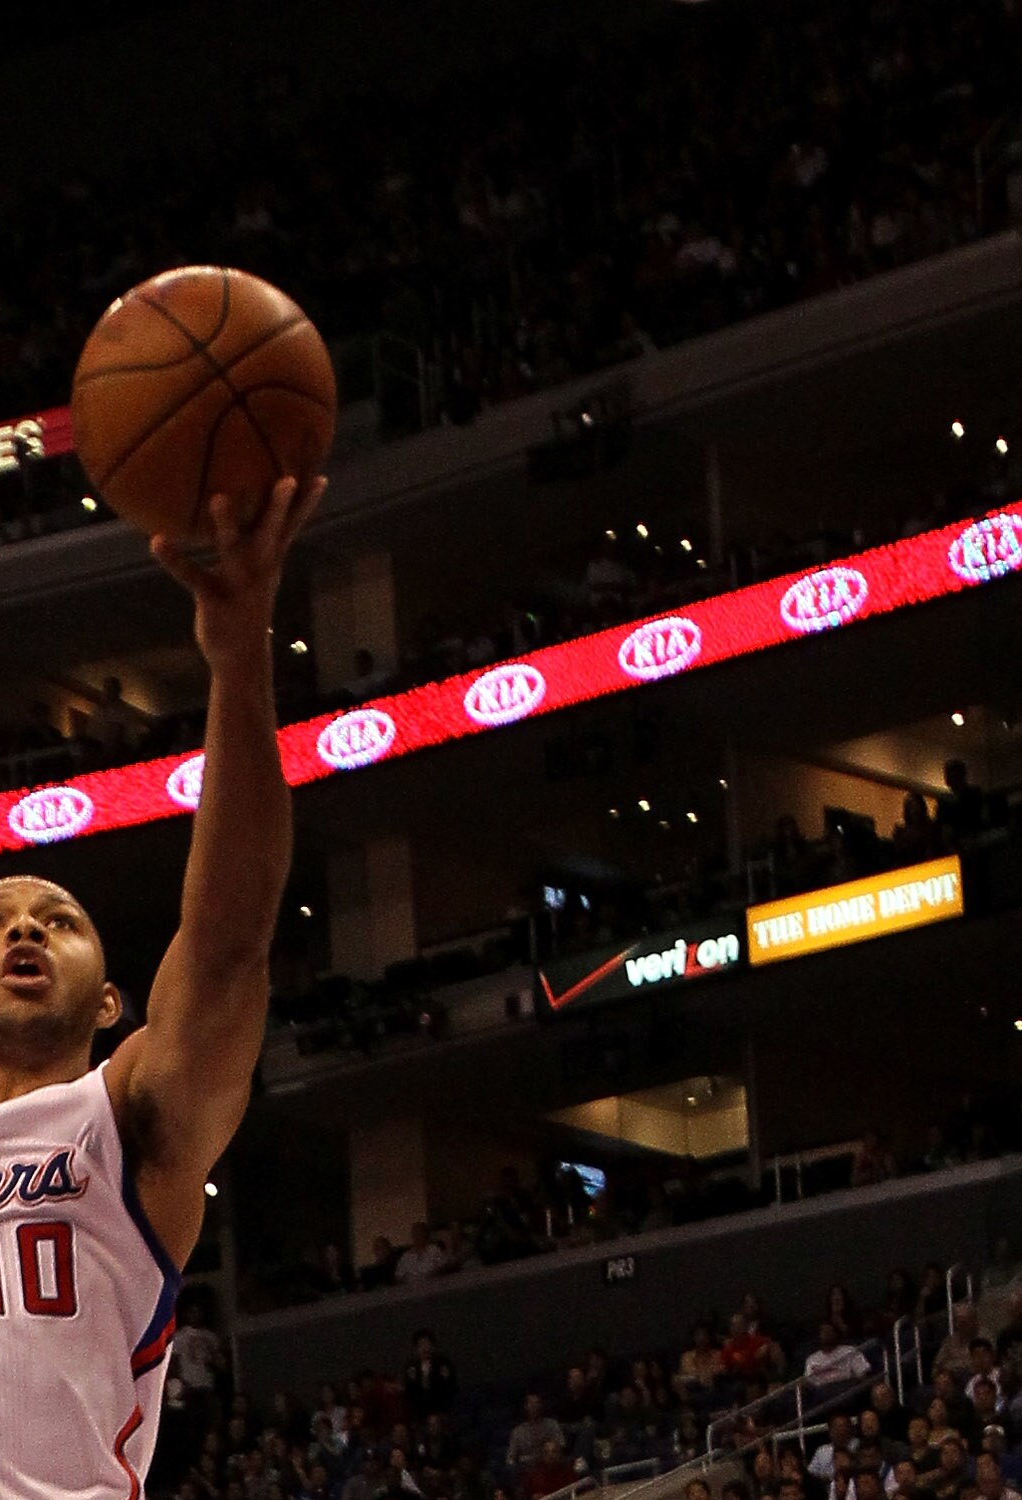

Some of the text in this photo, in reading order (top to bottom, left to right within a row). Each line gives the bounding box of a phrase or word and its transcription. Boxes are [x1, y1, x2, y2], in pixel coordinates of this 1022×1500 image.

[963, 525, 1020, 567] KIA
[795, 577, 851, 618] KIA
[632, 629, 689, 668] KIA
[477, 674, 531, 712] KIA
[328, 720, 384, 758] KIA
[22, 800, 77, 829] KIA
[752, 873, 958, 949] THE HOME DEPOT
[626, 931, 740, 986] verizon
